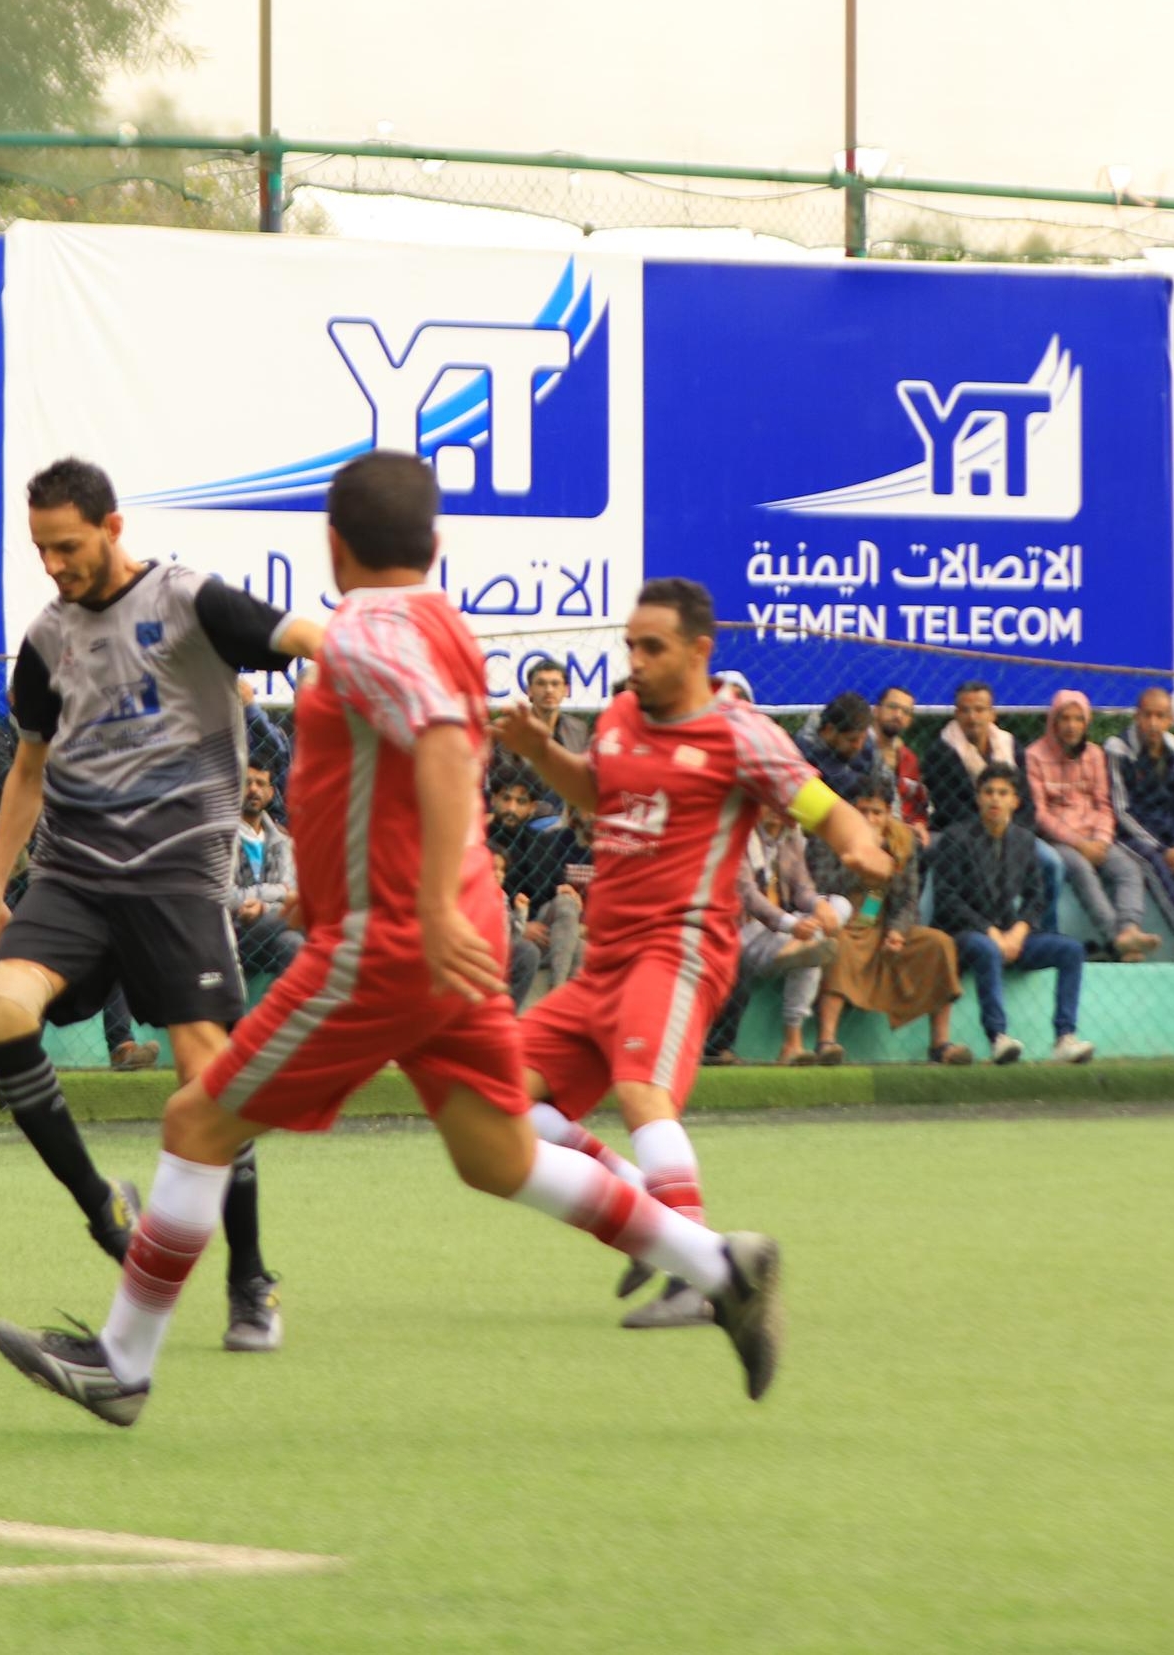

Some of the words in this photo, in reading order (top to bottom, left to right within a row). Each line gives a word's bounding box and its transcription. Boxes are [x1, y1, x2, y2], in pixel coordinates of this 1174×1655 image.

[326, 316, 571, 496] YT
[896, 380, 1053, 498] YT
[746, 540, 880, 598] اليمنية
[892, 542, 1082, 591] الاتصالات
[747, 602, 886, 643] YEMEN
[898, 605, 1082, 646] TELECOM
